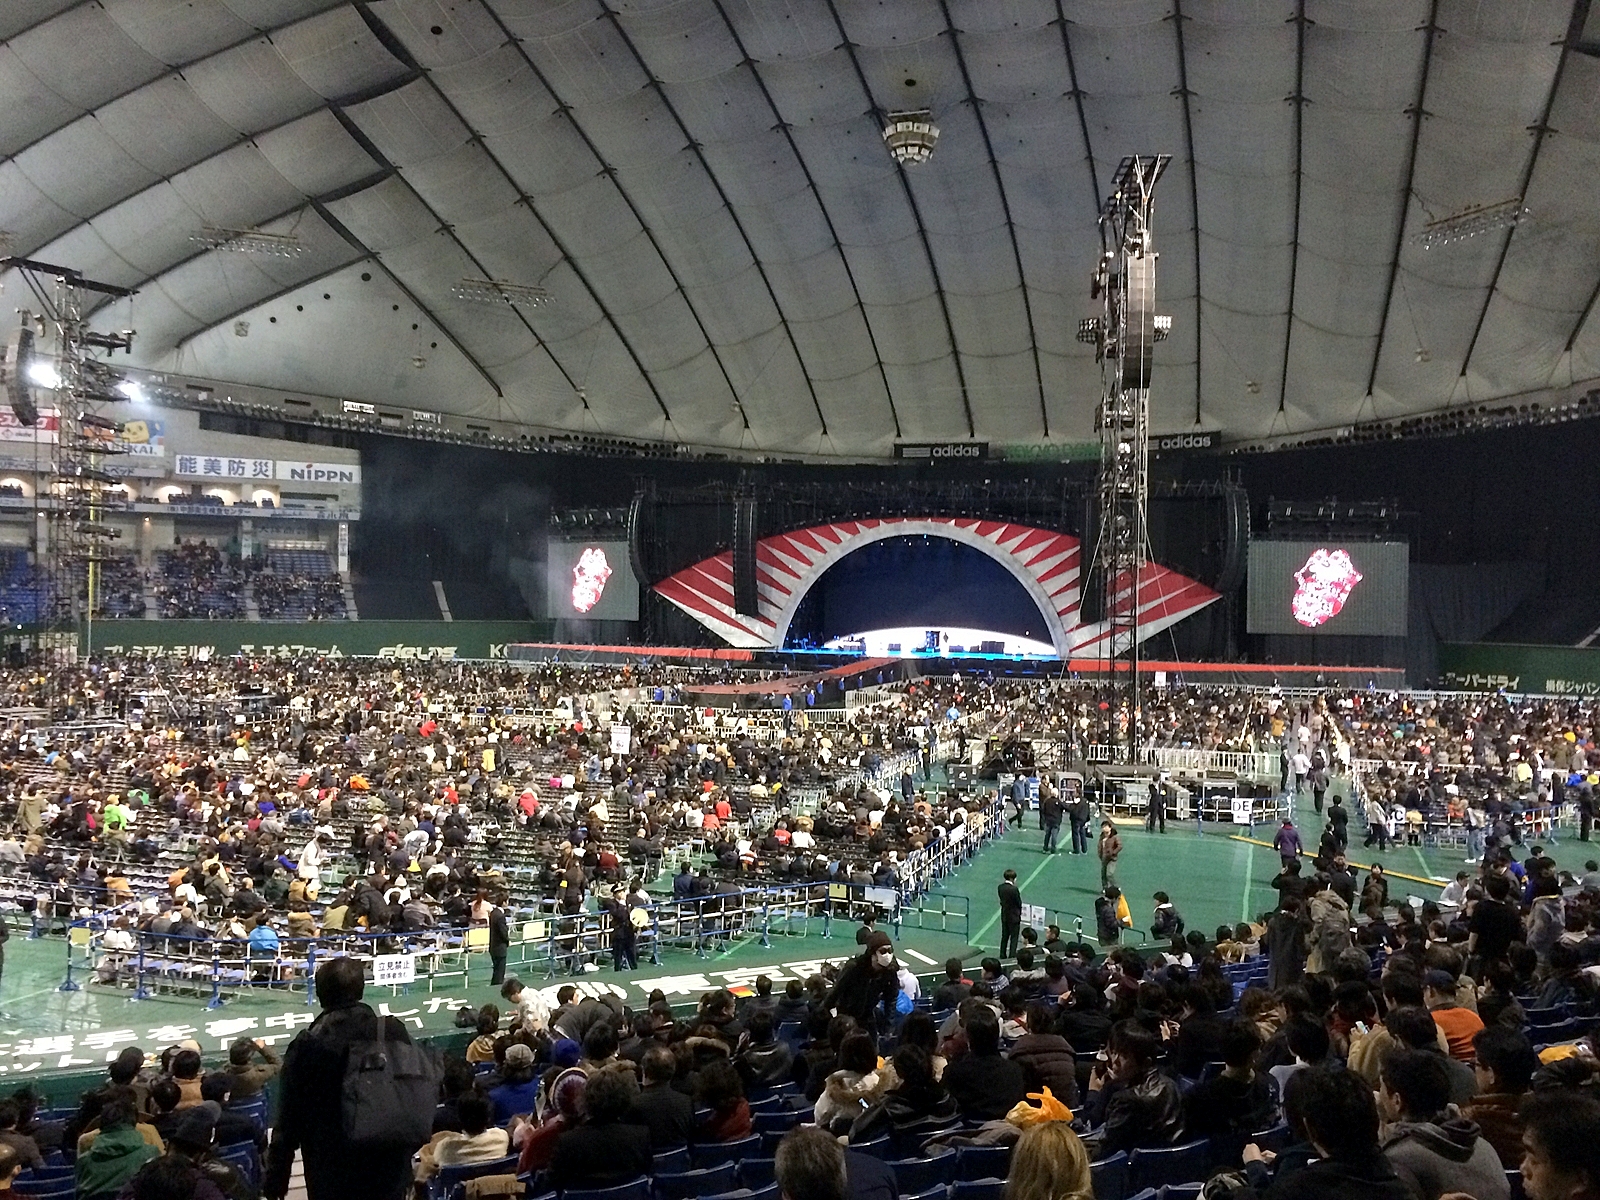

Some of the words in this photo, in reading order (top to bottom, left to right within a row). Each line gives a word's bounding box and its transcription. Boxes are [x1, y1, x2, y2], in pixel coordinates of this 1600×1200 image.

[1161, 434, 1211, 450] adidas
[932, 445, 980, 458] adidas
[178, 455, 270, 478] 能美防災
[1232, 800, 1250, 812] DE
[378, 960, 410, 972] 立見禁止
